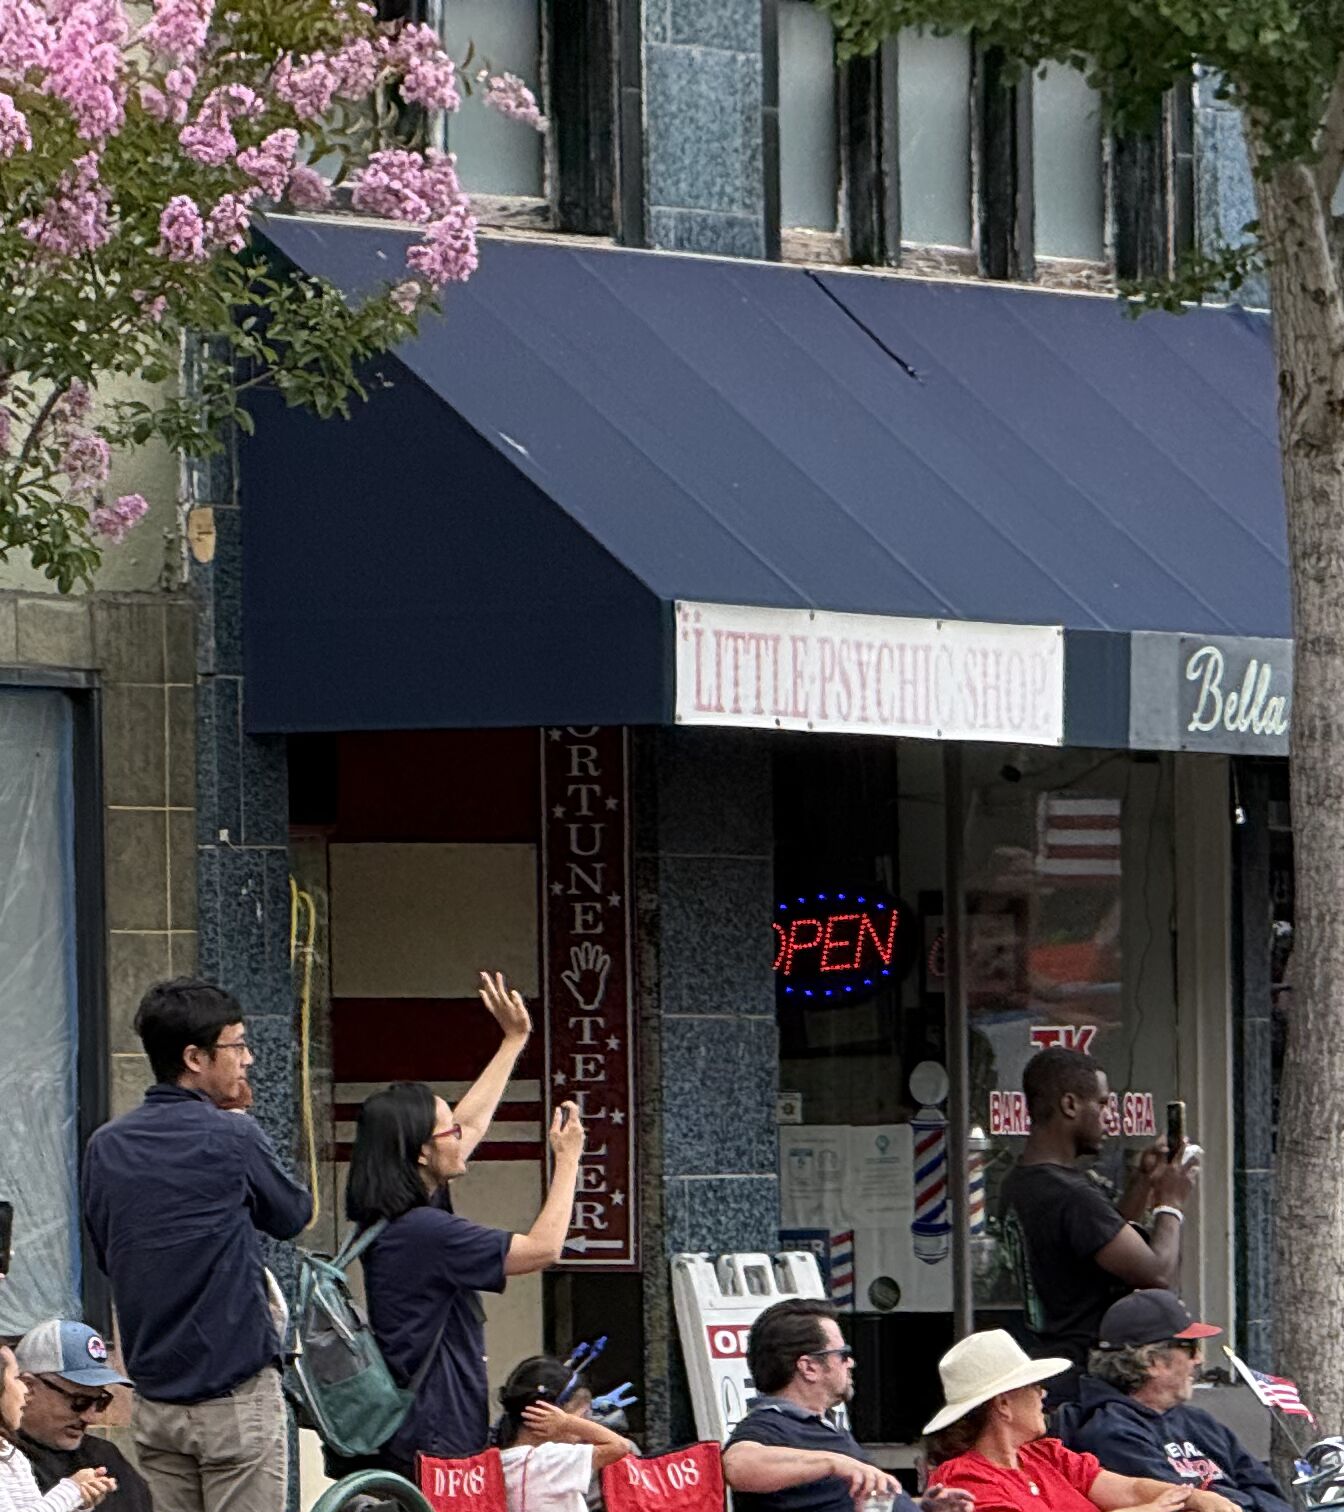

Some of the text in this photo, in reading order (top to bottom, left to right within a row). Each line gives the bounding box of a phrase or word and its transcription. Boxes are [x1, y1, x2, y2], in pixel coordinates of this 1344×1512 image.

[692, 627, 812, 719] LITTLE
[1186, 645, 1288, 736] Bella
[1123, 1092, 1157, 1136] SPA
